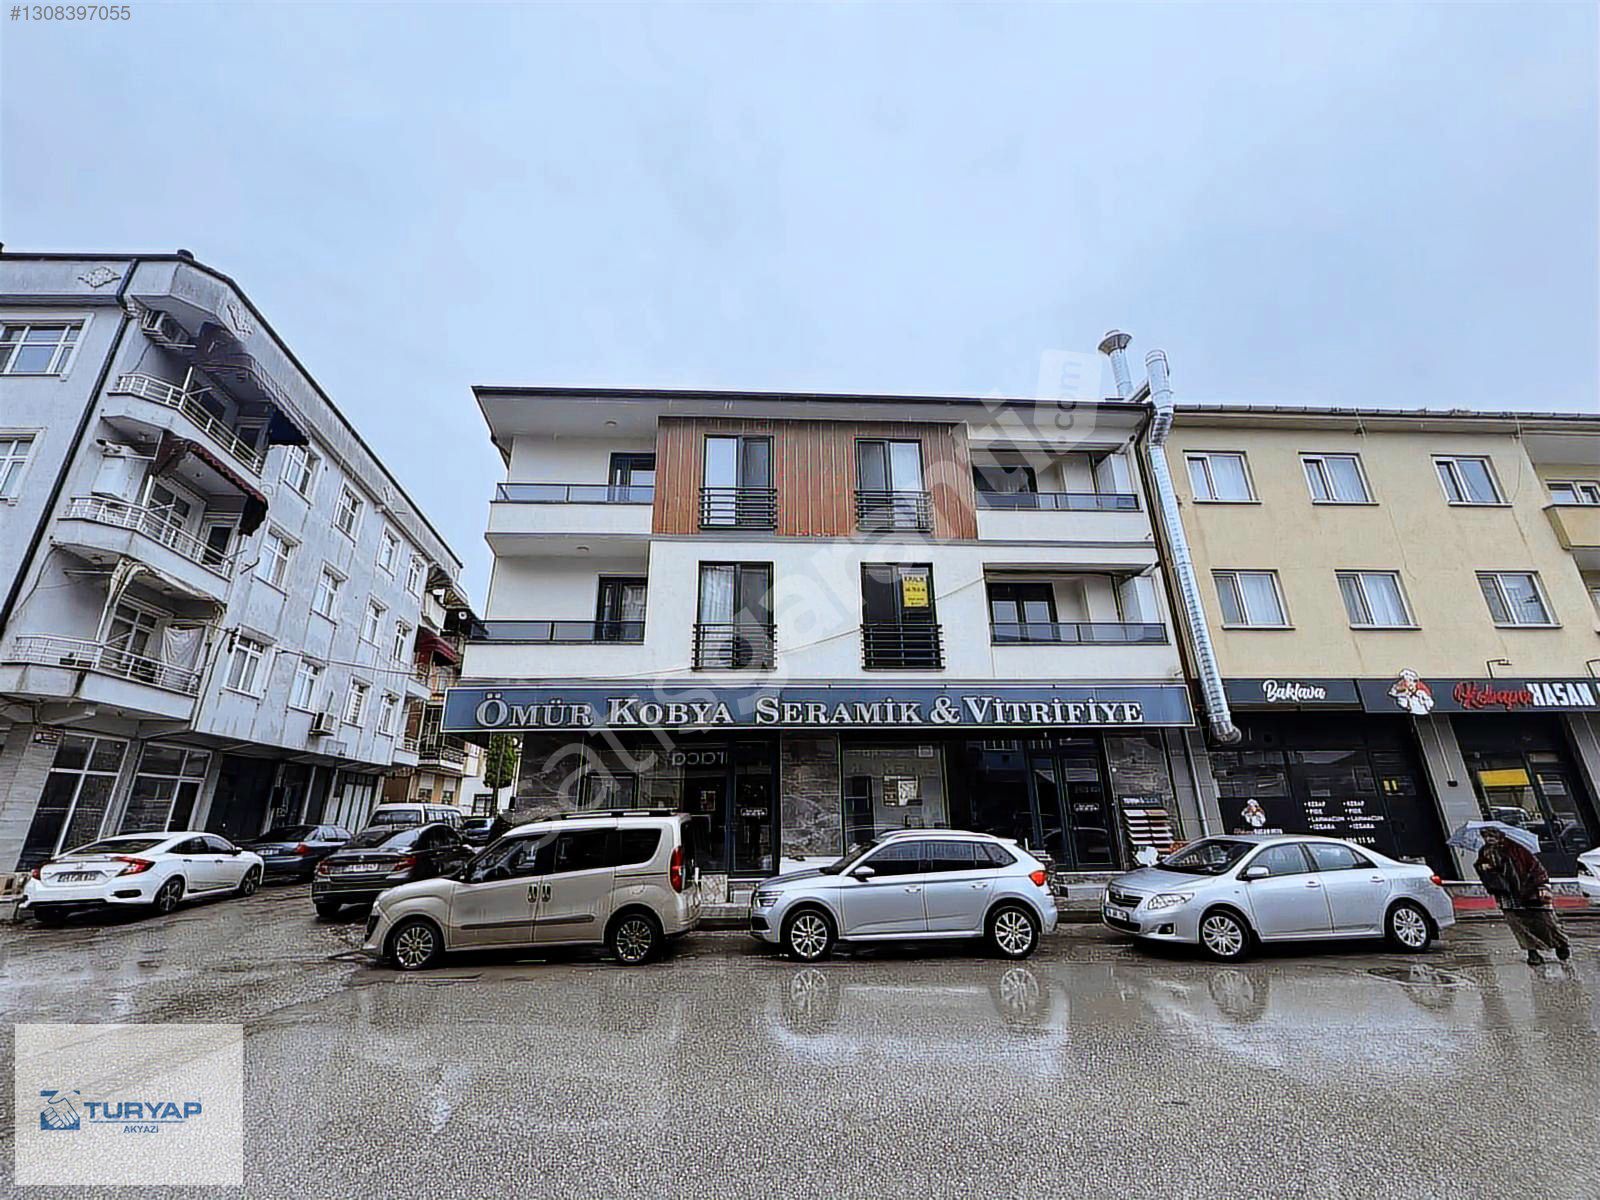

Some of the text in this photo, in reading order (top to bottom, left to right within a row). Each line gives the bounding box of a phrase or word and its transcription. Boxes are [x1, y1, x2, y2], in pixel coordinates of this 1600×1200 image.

[1262, 680, 1326, 702] Baklava
[475, 693, 1143, 727] ÖMÜR KOBYA SERAMİK & VİTRİFİYE
